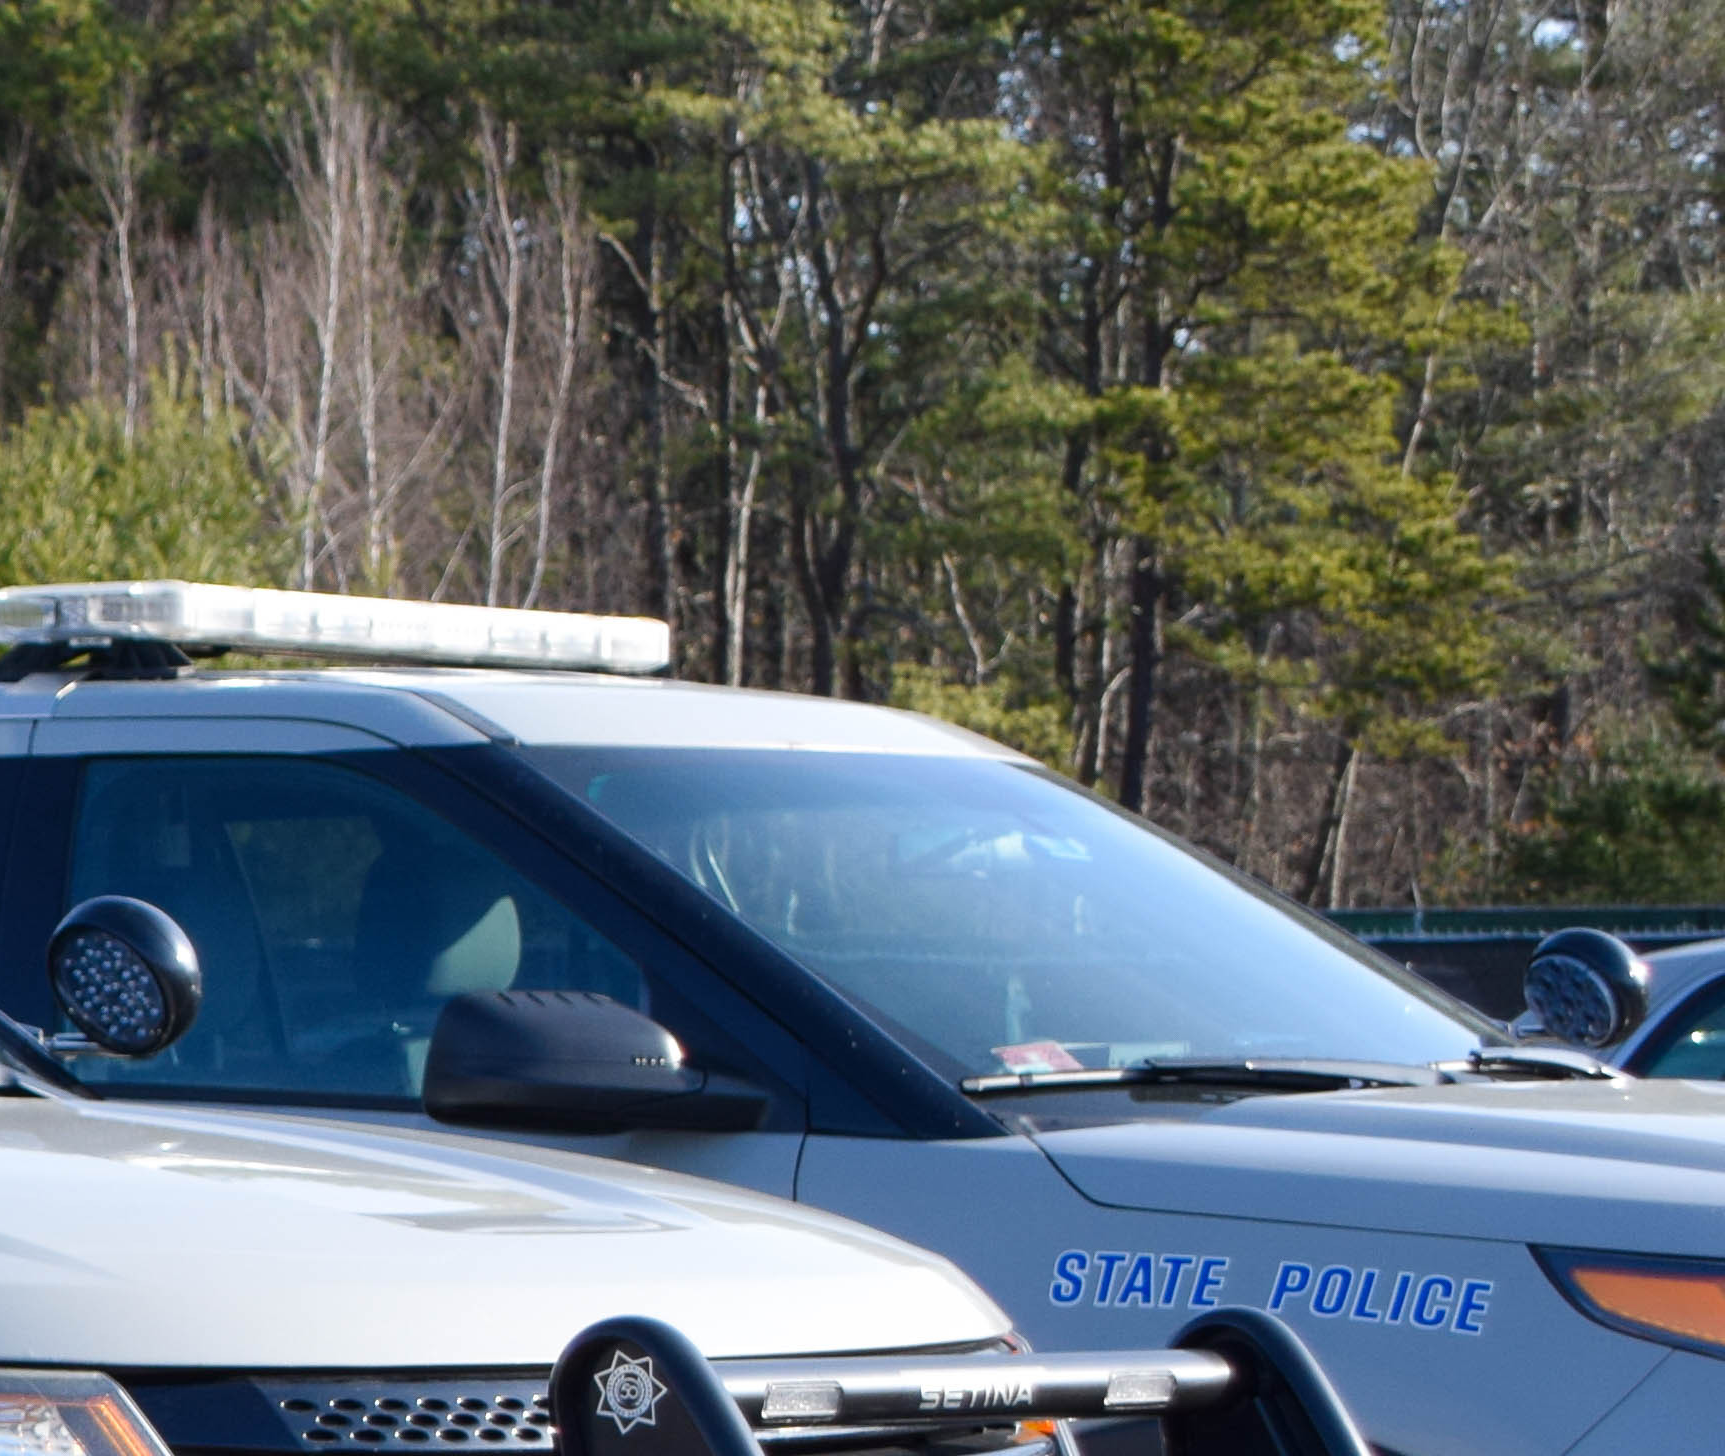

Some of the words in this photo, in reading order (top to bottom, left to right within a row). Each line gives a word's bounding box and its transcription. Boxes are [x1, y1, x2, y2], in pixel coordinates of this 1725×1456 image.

[1048, 1248, 1231, 1311] STATE
[1269, 1260, 1497, 1337] POLICE
[919, 1382, 1034, 1410] SETINA
